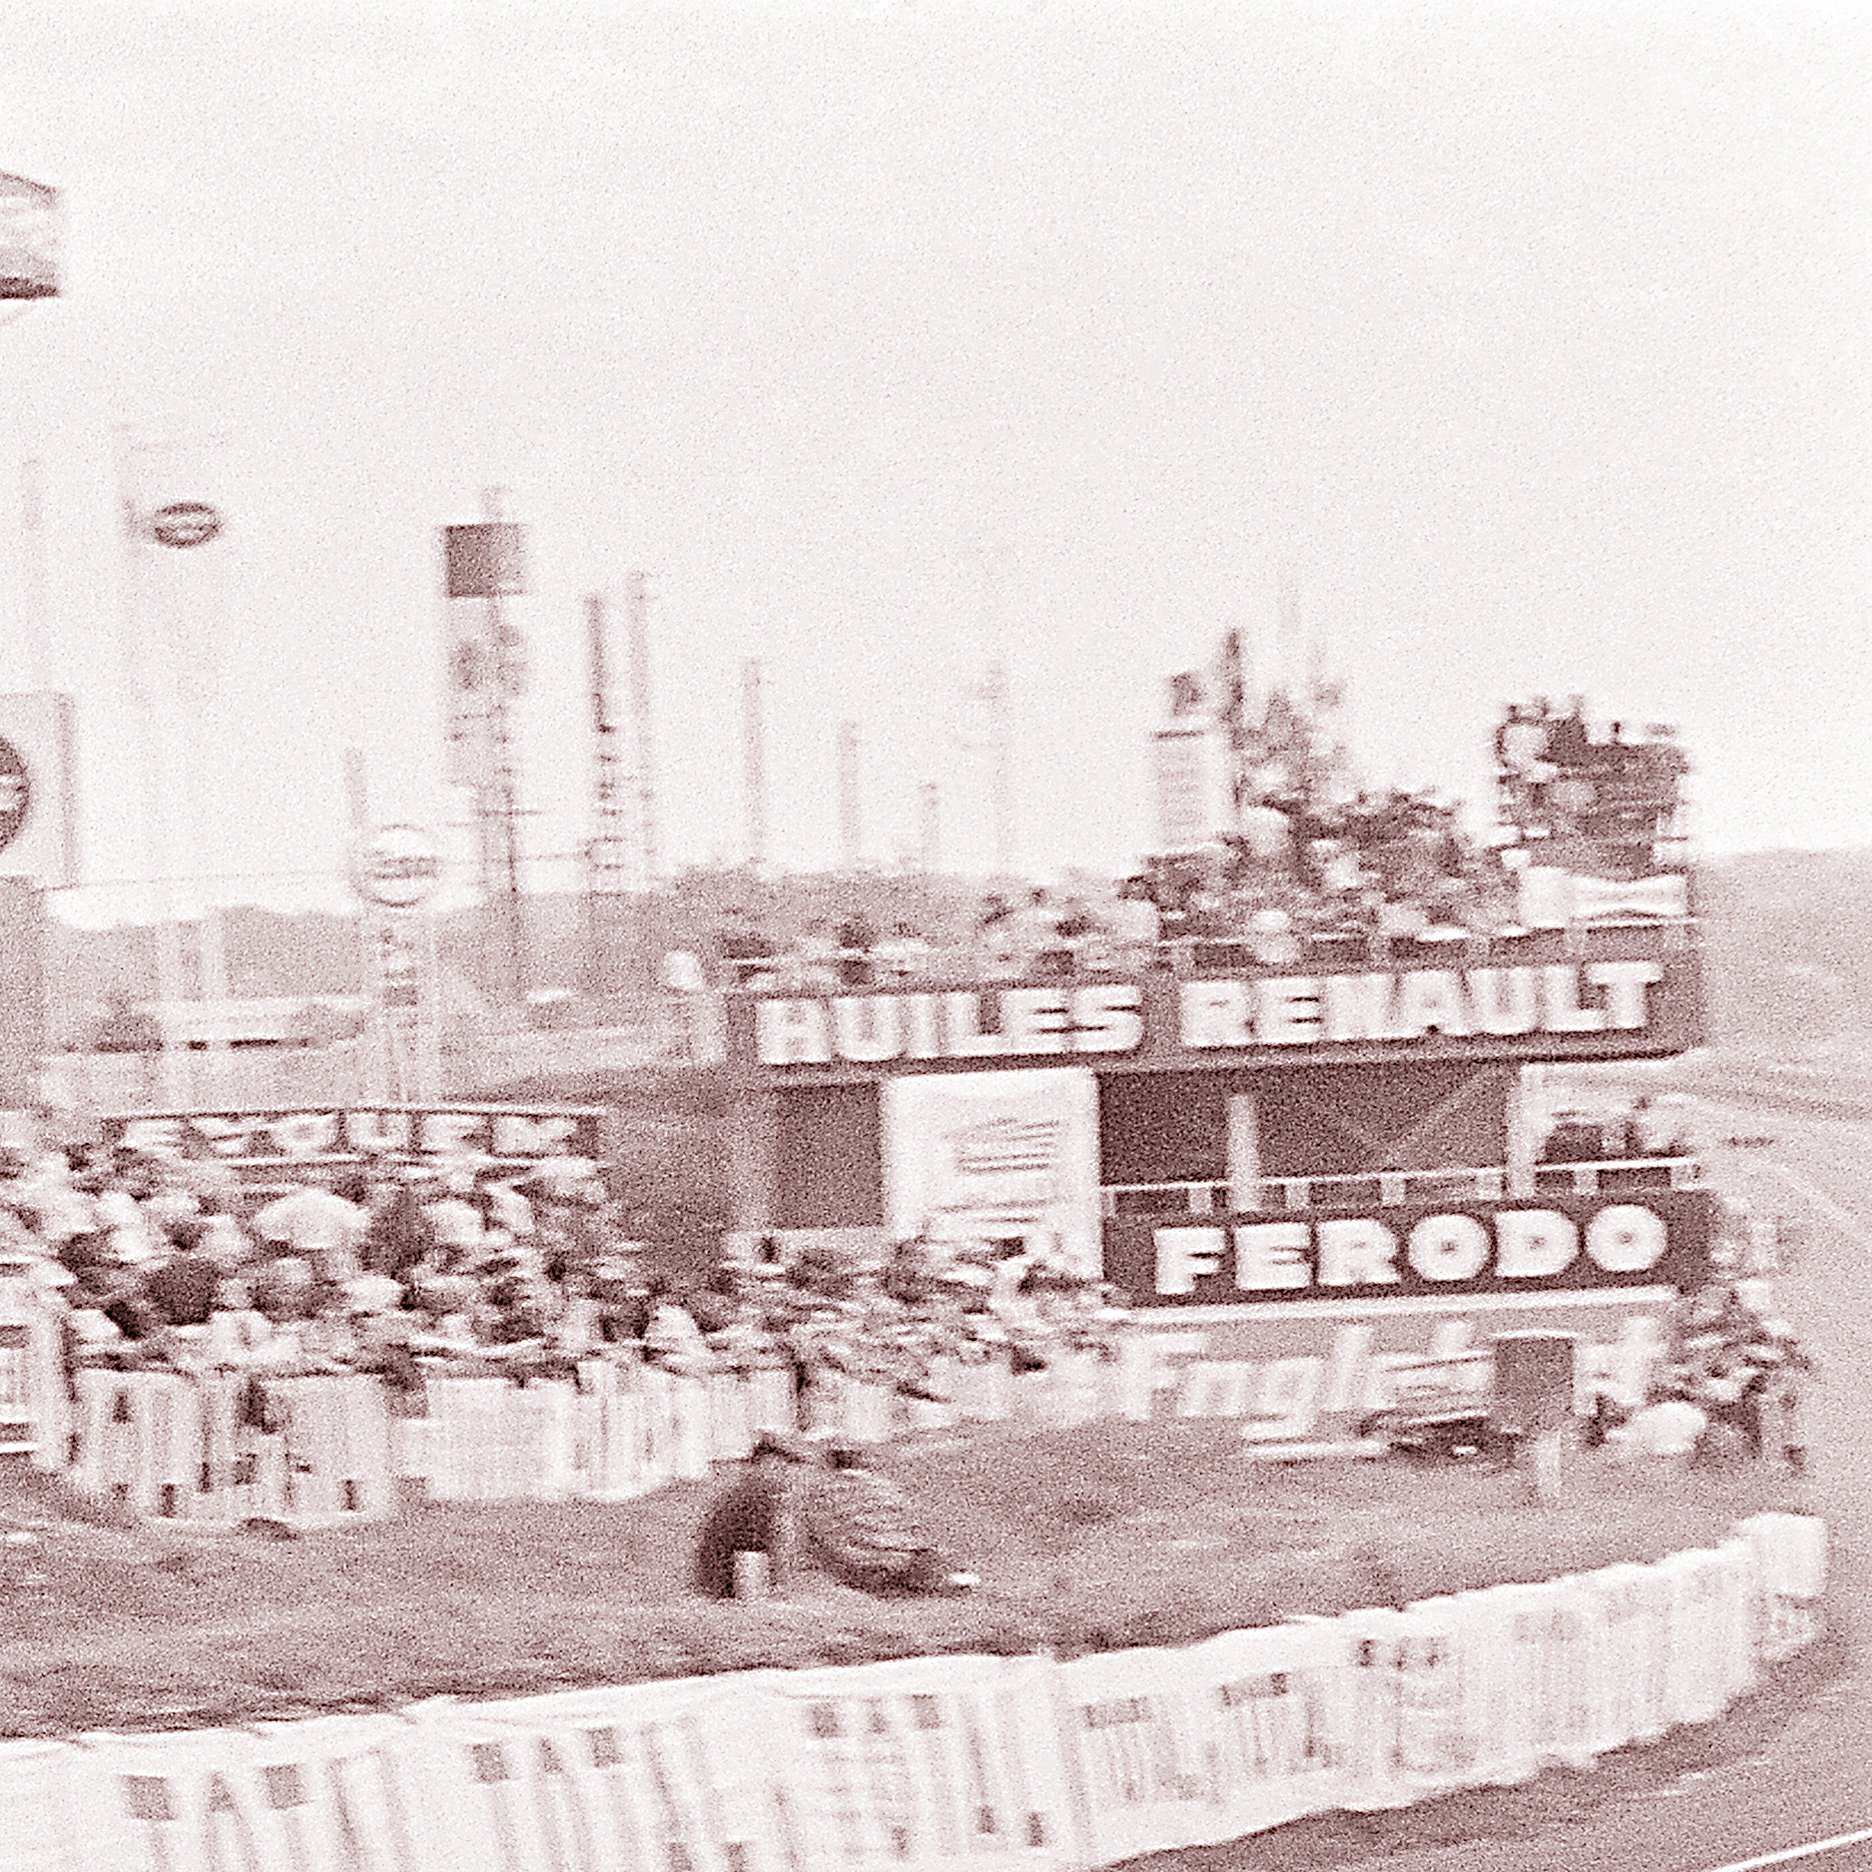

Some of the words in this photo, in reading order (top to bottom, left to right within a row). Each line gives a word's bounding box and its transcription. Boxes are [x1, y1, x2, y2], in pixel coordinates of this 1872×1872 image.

[755, 986, 1143, 1066] HUILES
[1180, 961, 1660, 1049] RENAULT
[1155, 1203, 1668, 1296] FERODO
